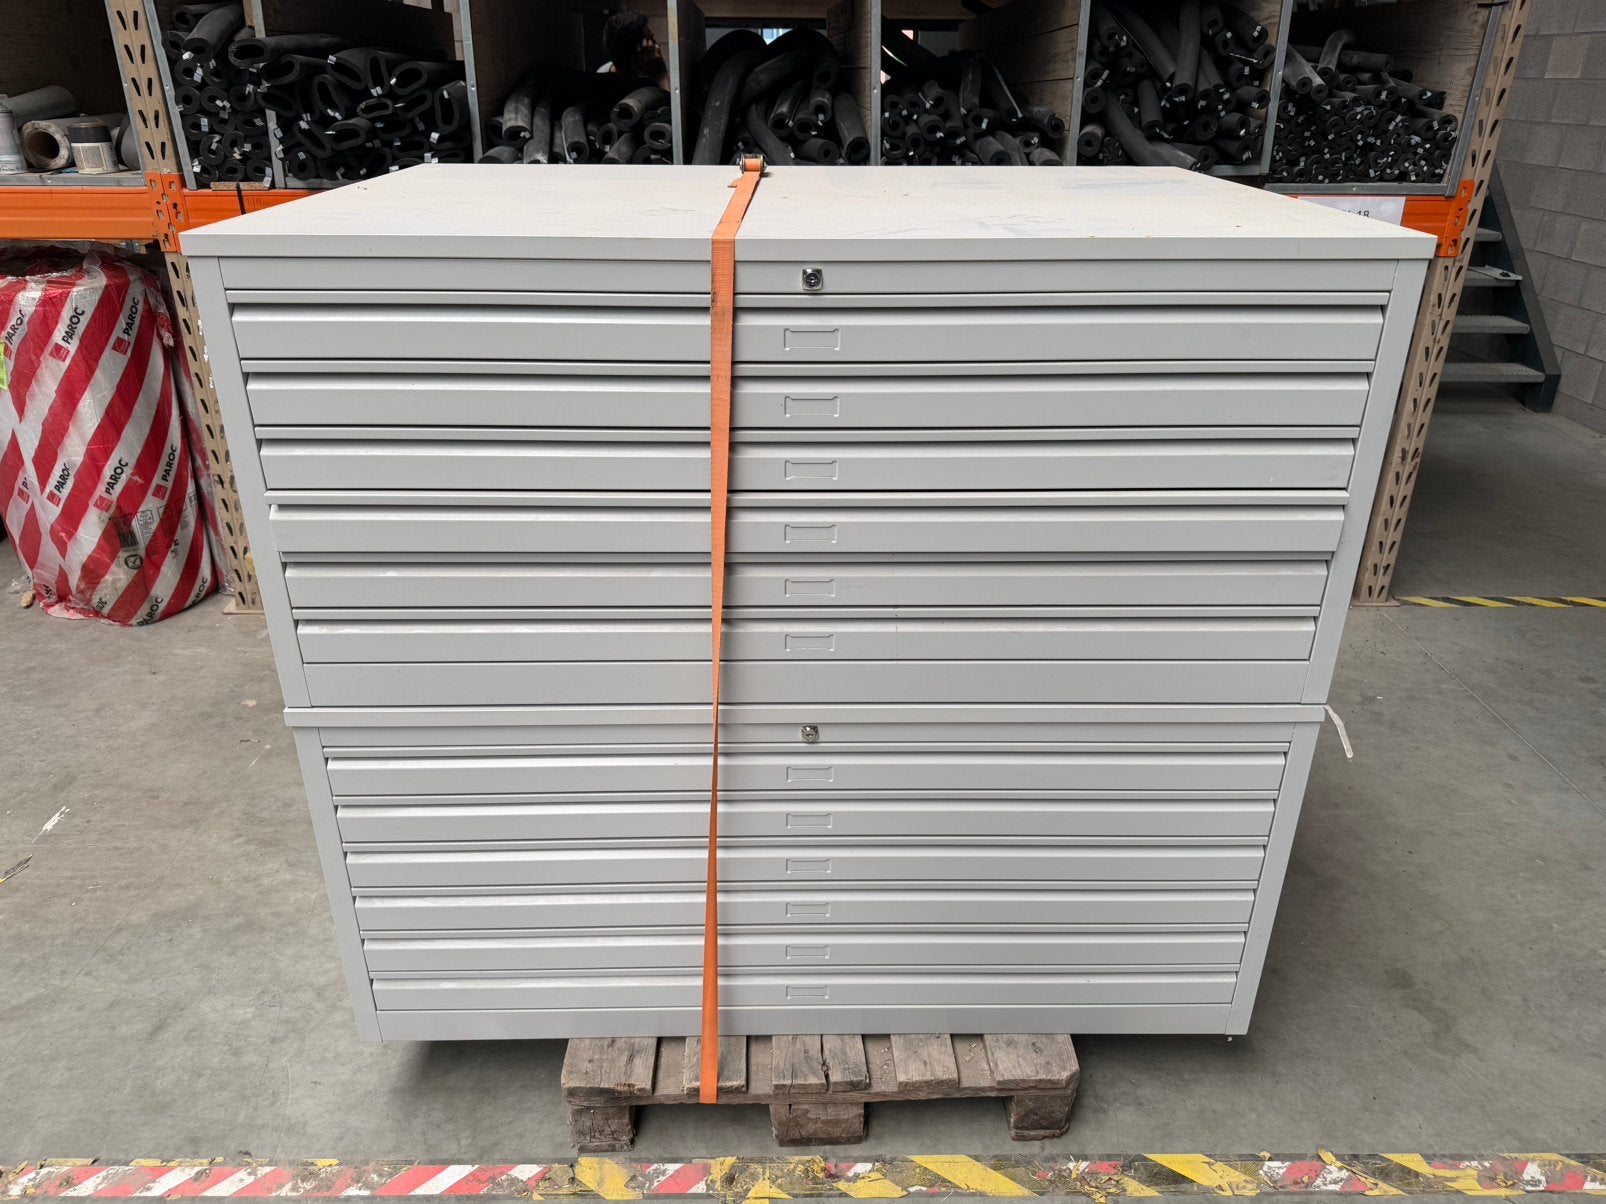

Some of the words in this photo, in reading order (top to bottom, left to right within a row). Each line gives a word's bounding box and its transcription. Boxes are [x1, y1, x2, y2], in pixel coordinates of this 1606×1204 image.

[61, 304, 86, 345] PAROC
[123, 297, 140, 337] PAROC
[105, 456, 129, 496] PAROC
[161, 444, 178, 483] PAROC
